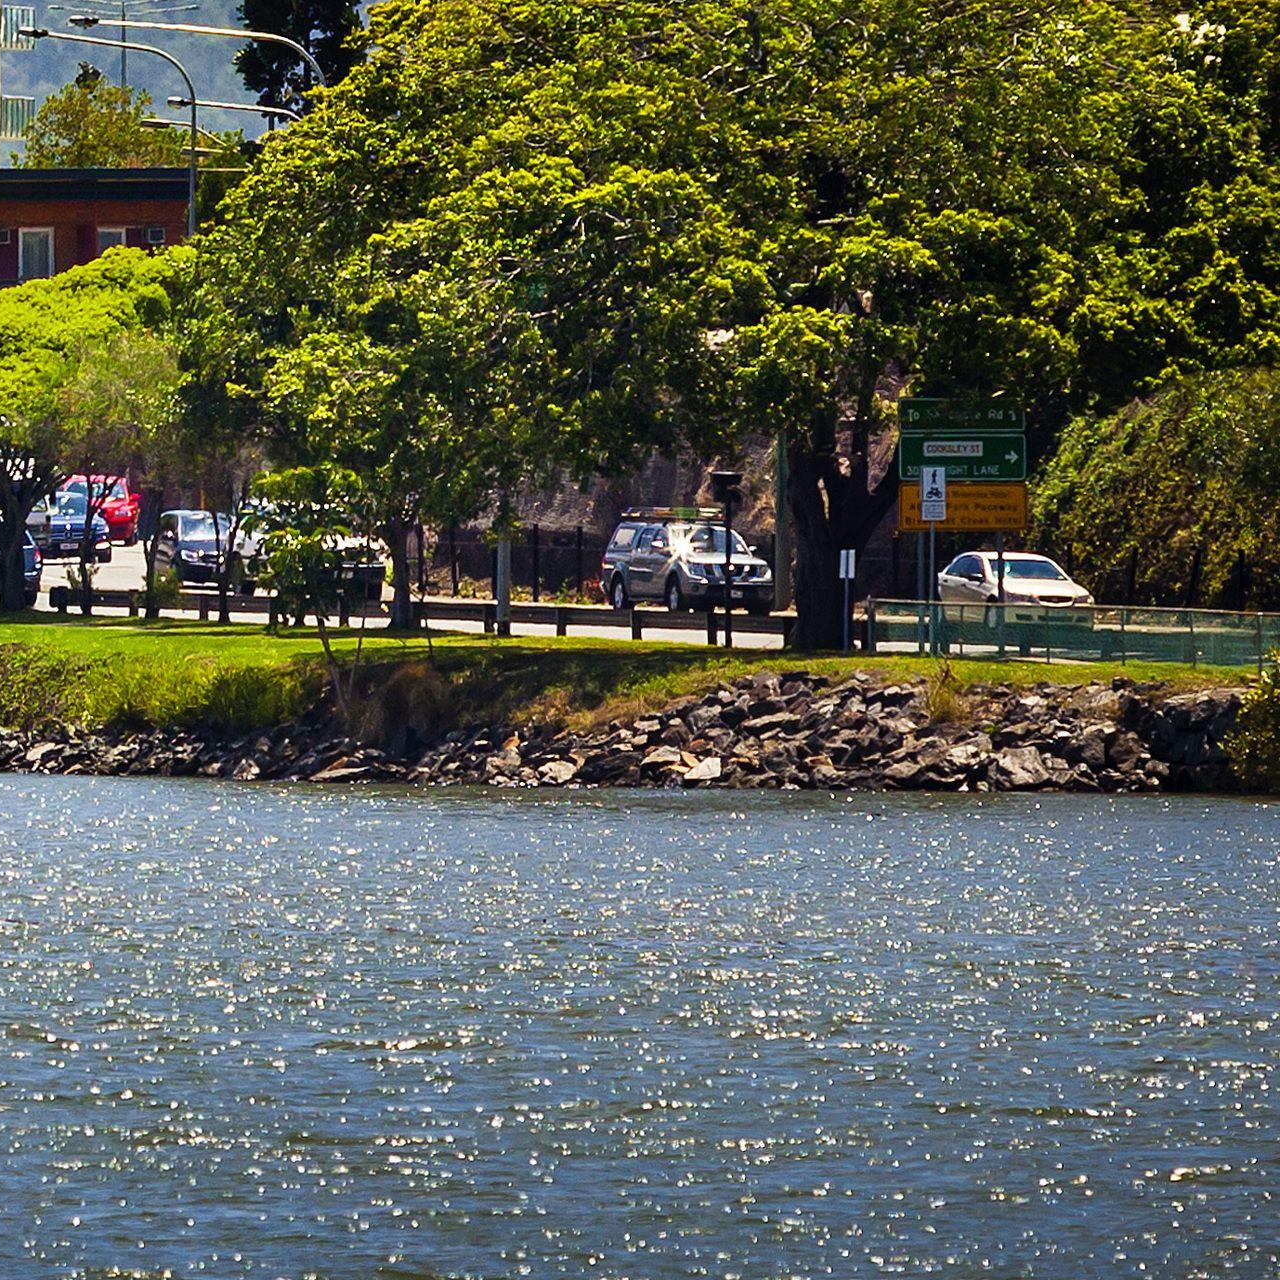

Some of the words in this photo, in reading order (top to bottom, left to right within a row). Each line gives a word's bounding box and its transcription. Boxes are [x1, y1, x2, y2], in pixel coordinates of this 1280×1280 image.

[907, 409, 920, 422] To
[945, 465, 968, 475] IGHT
[973, 465, 1000, 475] LANE
